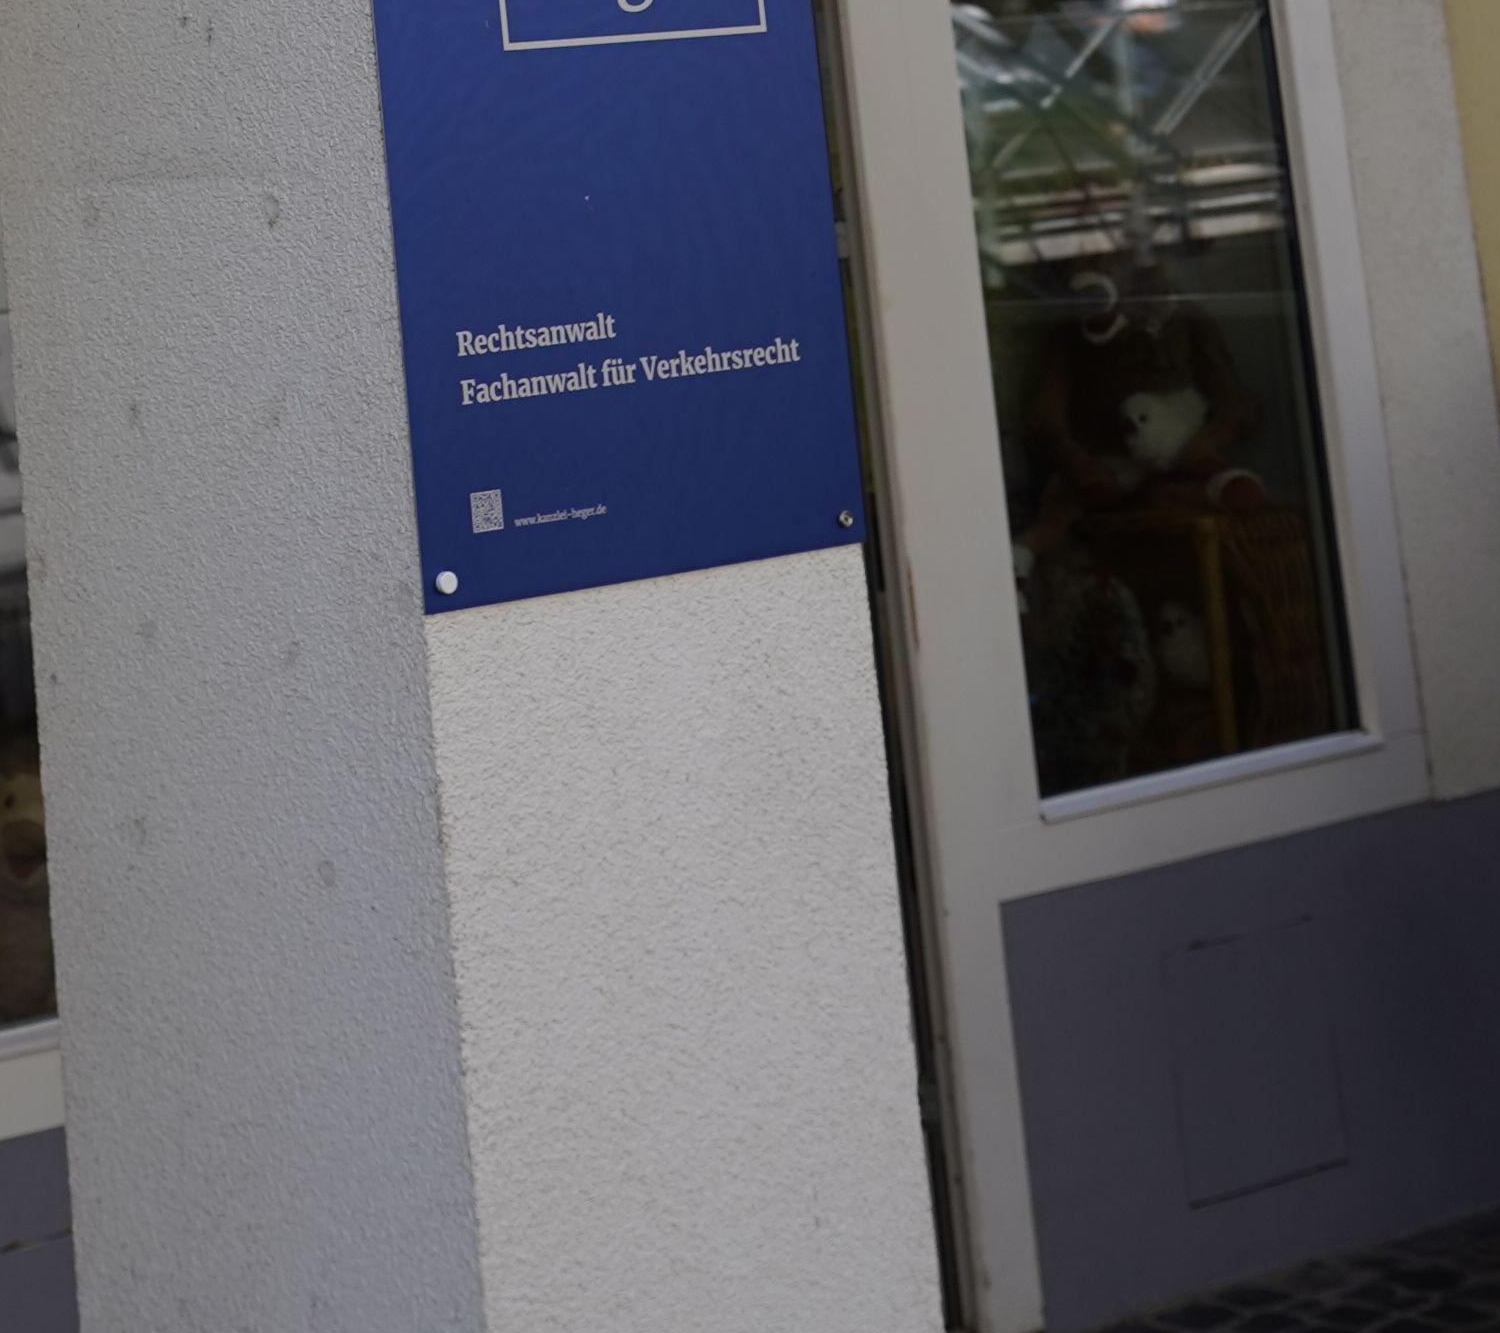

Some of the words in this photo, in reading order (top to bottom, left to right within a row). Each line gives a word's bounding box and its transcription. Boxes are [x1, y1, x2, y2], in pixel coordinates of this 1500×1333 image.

[456, 312, 617, 357] Rechtsanwalt
[460, 363, 598, 406] Fachanwalt
[601, 359, 636, 387] für
[640, 337, 801, 382] Verkehrsrecht
